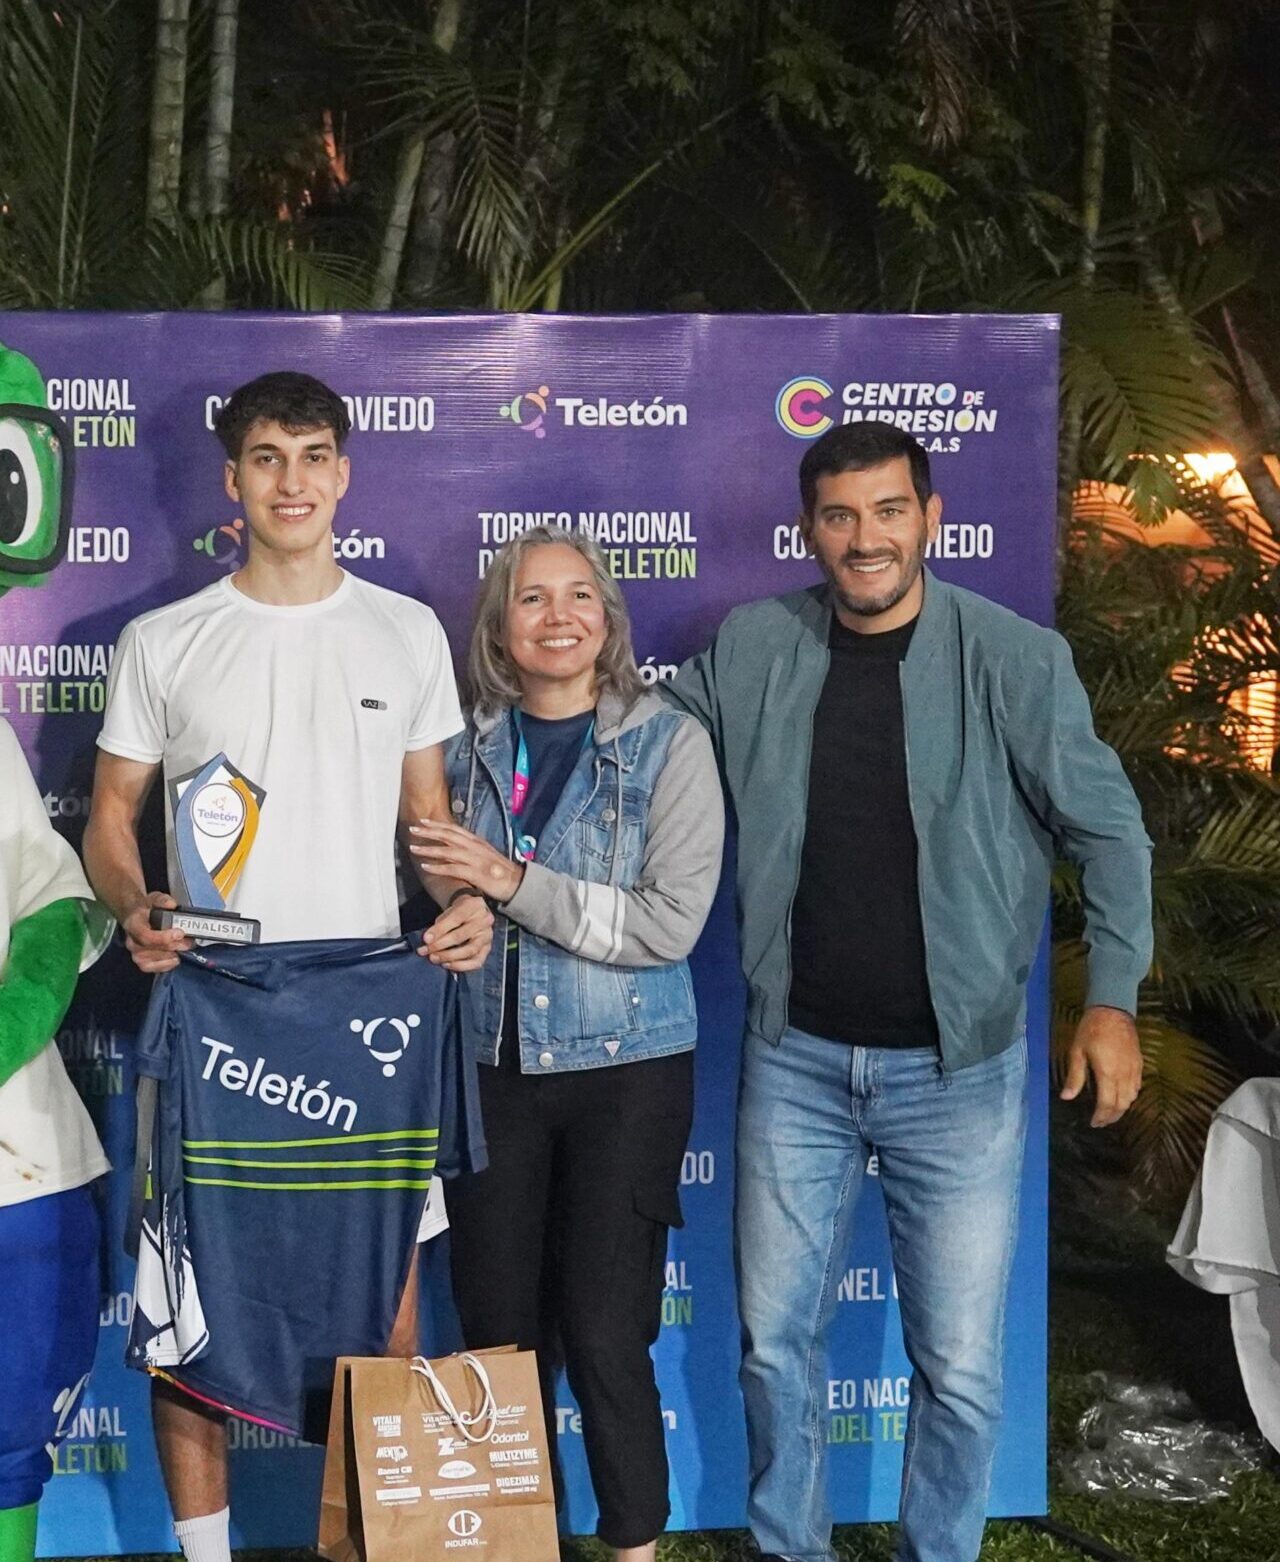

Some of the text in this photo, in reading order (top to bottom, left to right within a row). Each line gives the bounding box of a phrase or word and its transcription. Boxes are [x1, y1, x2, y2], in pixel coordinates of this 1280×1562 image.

[46, 378, 136, 411] CIONAL
[842, 383, 984, 406] CENTRO DE
[556, 396, 687, 426] Teletón
[579, 511, 697, 543] NACIONAL
[16, 676, 105, 713] TELETÓ
[197, 808, 238, 823] Teletón
[179, 918, 245, 936] FINALISTA
[200, 1036, 359, 1132] Teletón
[372, 1415, 401, 1426] VITALIN
[491, 1431, 529, 1445] Odontol
[489, 1448, 538, 1462] MULTIZYME
[496, 1475, 540, 1488] DIGEZIMAS
[444, 1538, 479, 1549] INDUFAR
